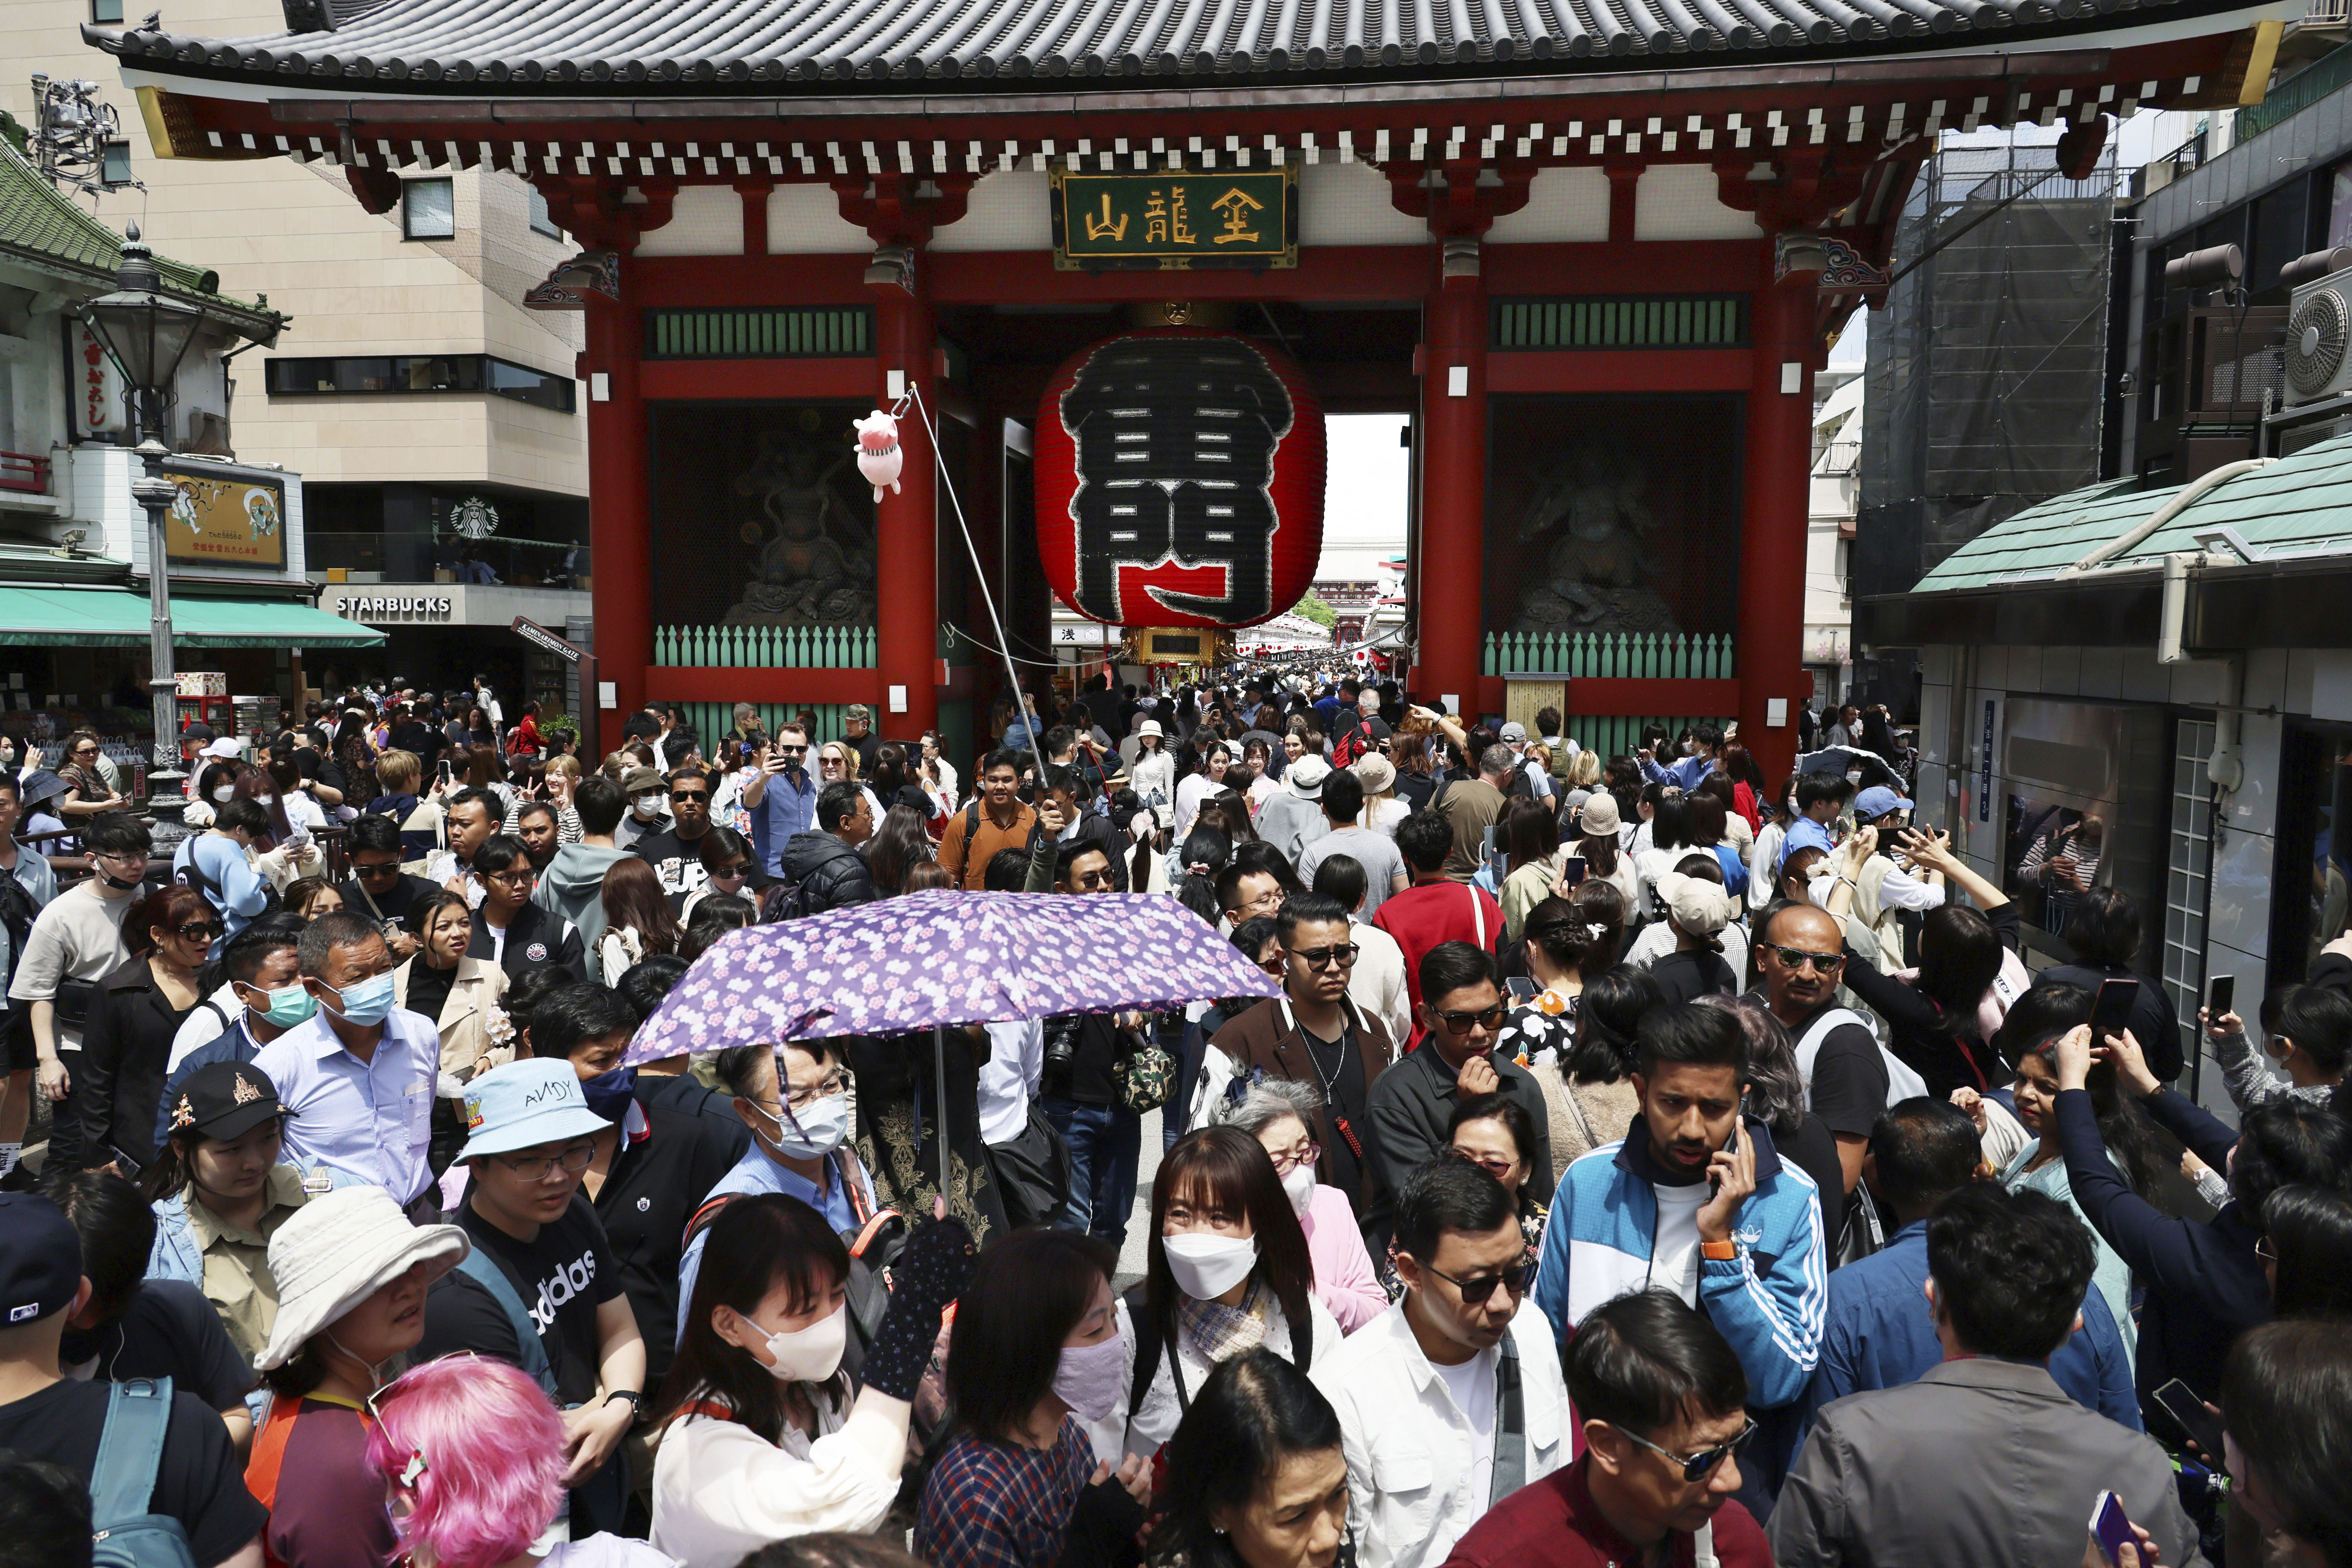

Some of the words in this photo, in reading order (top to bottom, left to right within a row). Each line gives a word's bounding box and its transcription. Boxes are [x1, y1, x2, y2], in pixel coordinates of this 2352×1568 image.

[1058, 336, 1295, 624] 雷門
[336, 597, 450, 612] STARBUCKS
[522, 624, 564, 649] KAMINARIMON
[563, 647, 579, 659] GATE
[525, 1080, 573, 1107] ANDY
[469, 1117, 482, 1127] TORY
